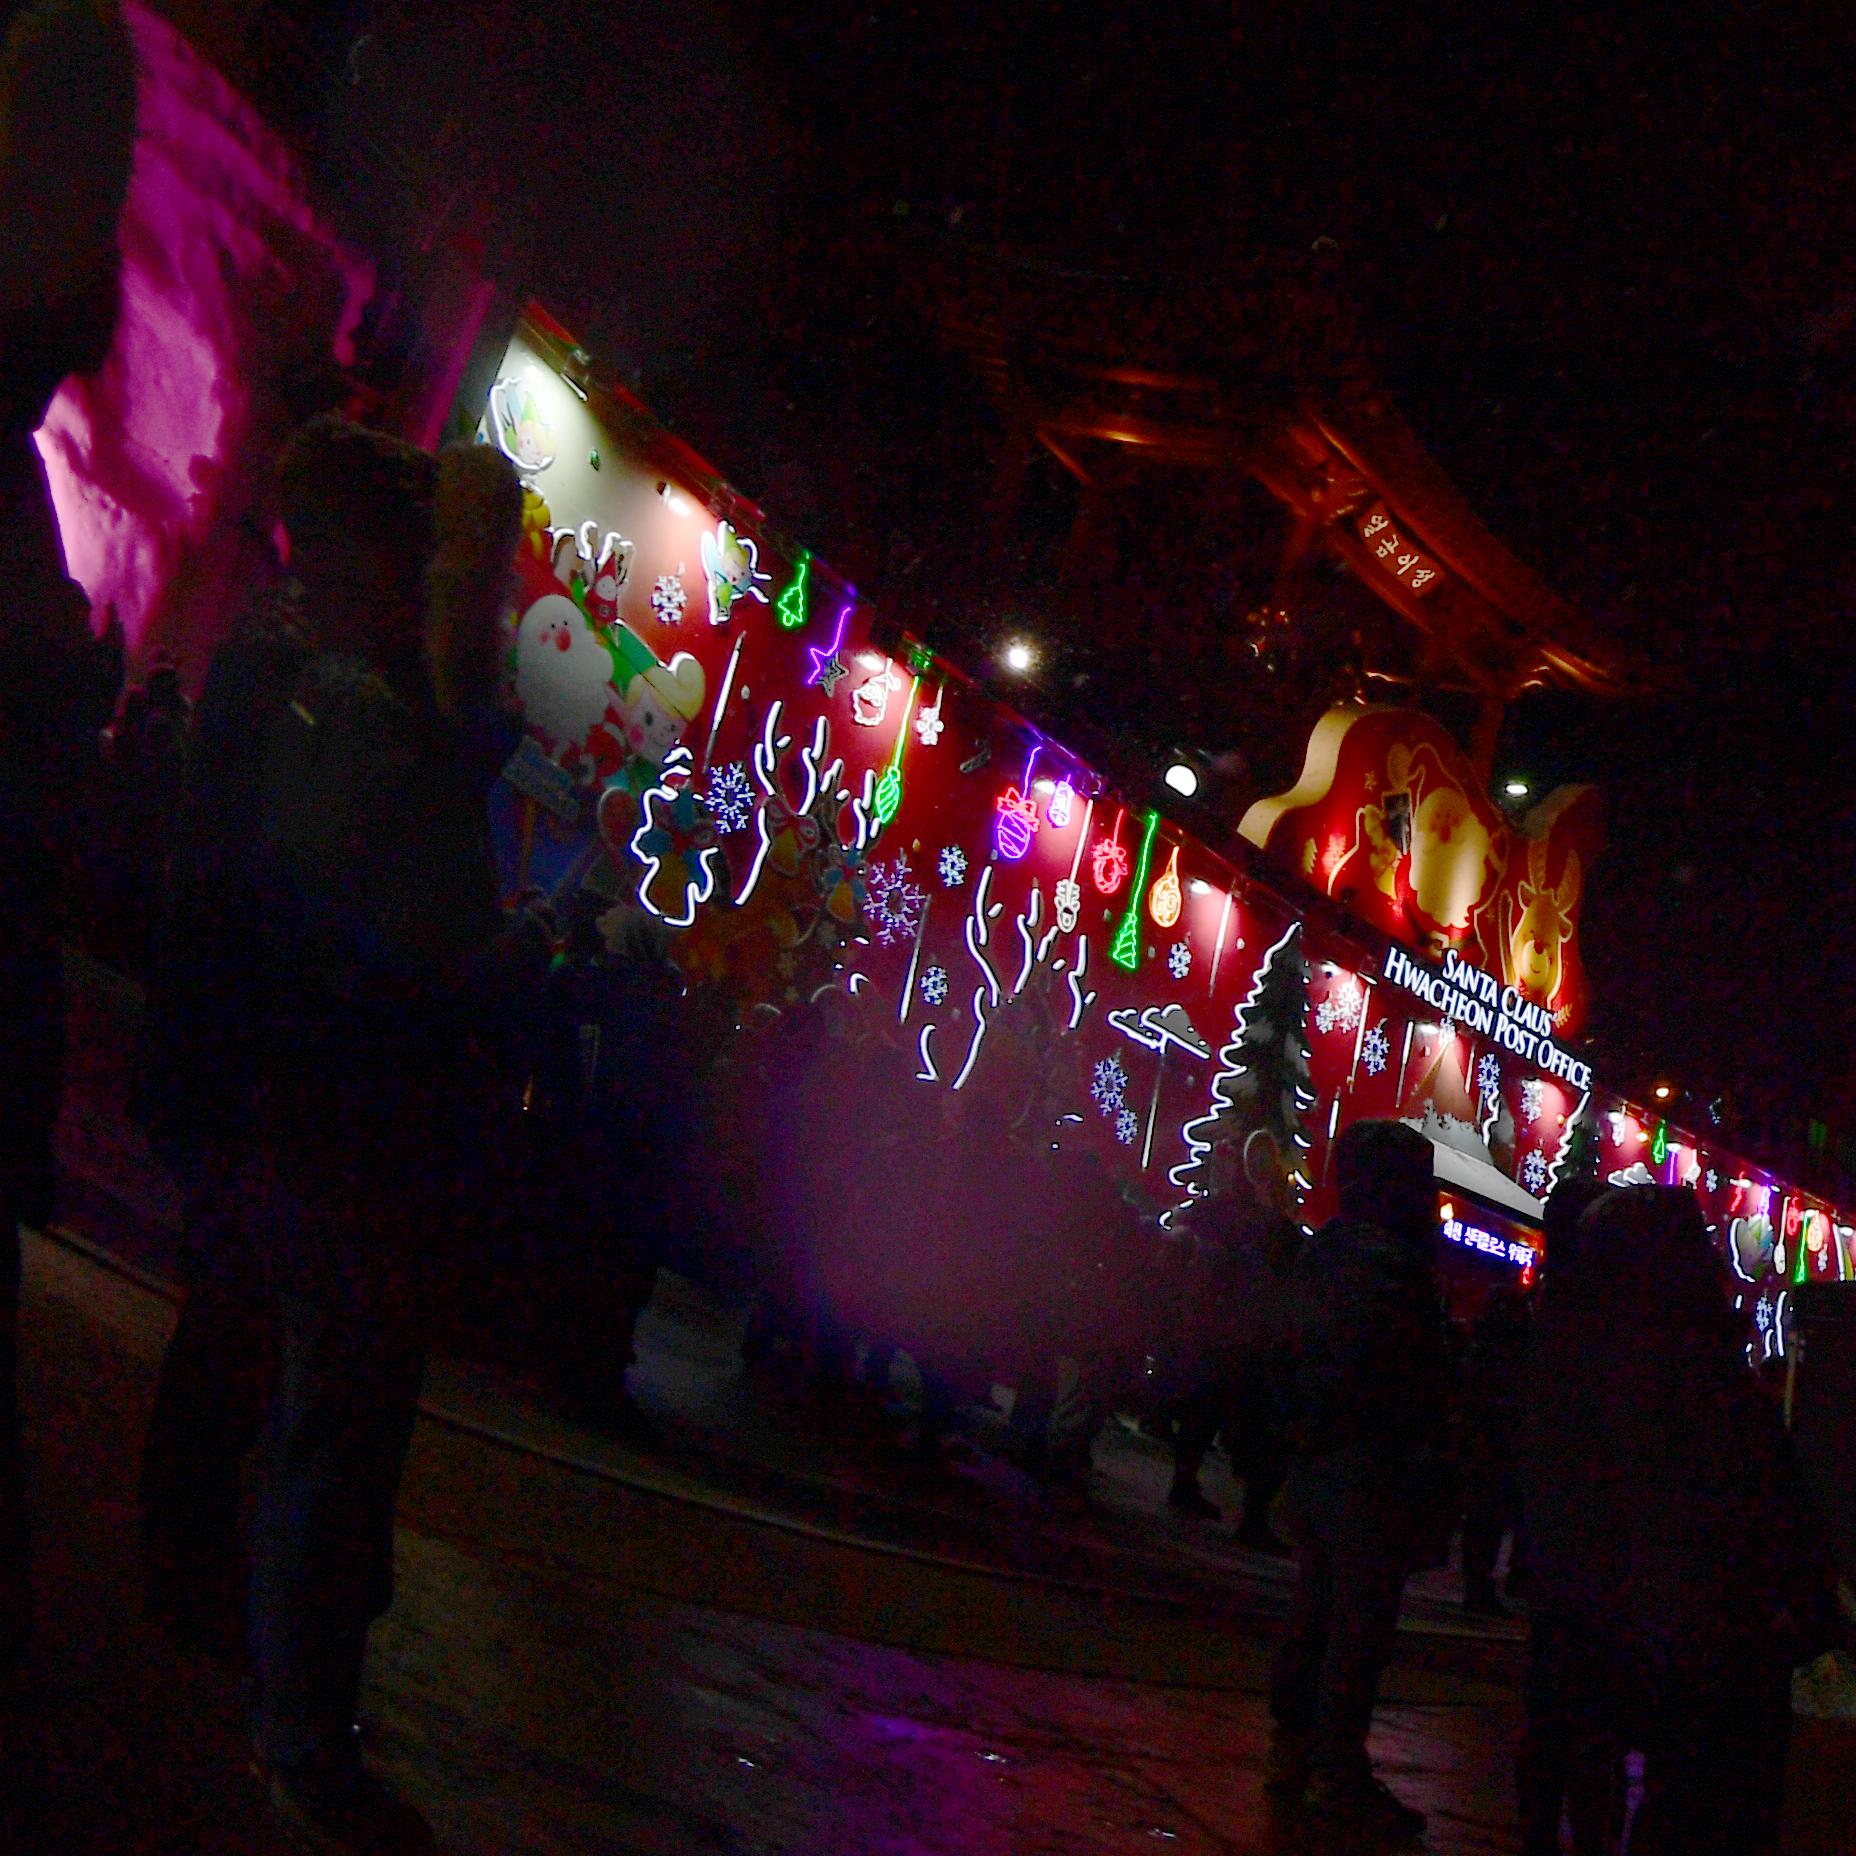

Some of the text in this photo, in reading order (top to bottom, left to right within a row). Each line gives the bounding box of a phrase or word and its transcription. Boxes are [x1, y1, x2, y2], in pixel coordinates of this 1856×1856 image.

[1384, 946, 1593, 1091] HWACHEON POST OFFICE
[1442, 949, 1552, 1037] SANTA CLAUS
[1464, 1226, 1506, 1257] 산타클로스
[1508, 1242, 1535, 1267] 우체국
